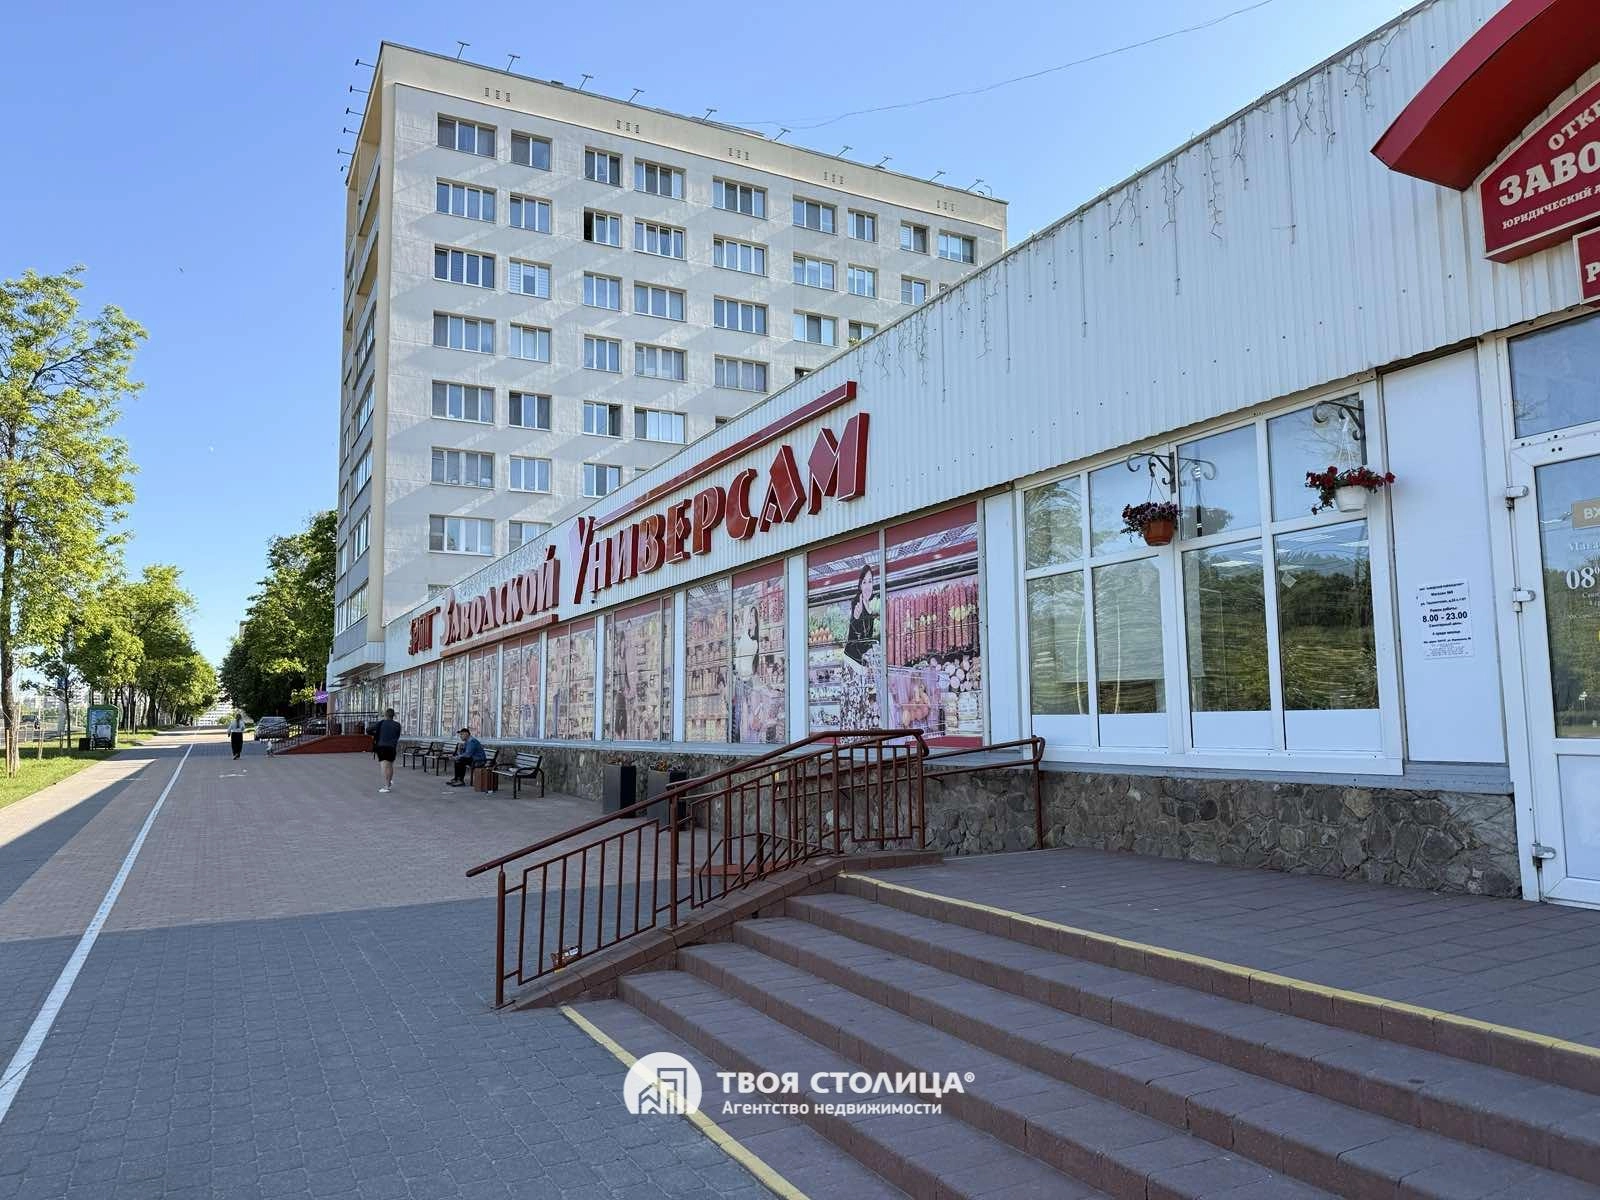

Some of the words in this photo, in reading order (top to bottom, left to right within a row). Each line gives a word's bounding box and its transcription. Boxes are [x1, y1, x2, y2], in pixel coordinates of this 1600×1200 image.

[1499, 141, 1600, 206] ЗАВО
[1502, 186, 1592, 230] ЮРИДИЧЕСКИЙ
[1422, 614, 1439, 623] 8.00
[1446, 611, 1468, 621] 23.00
